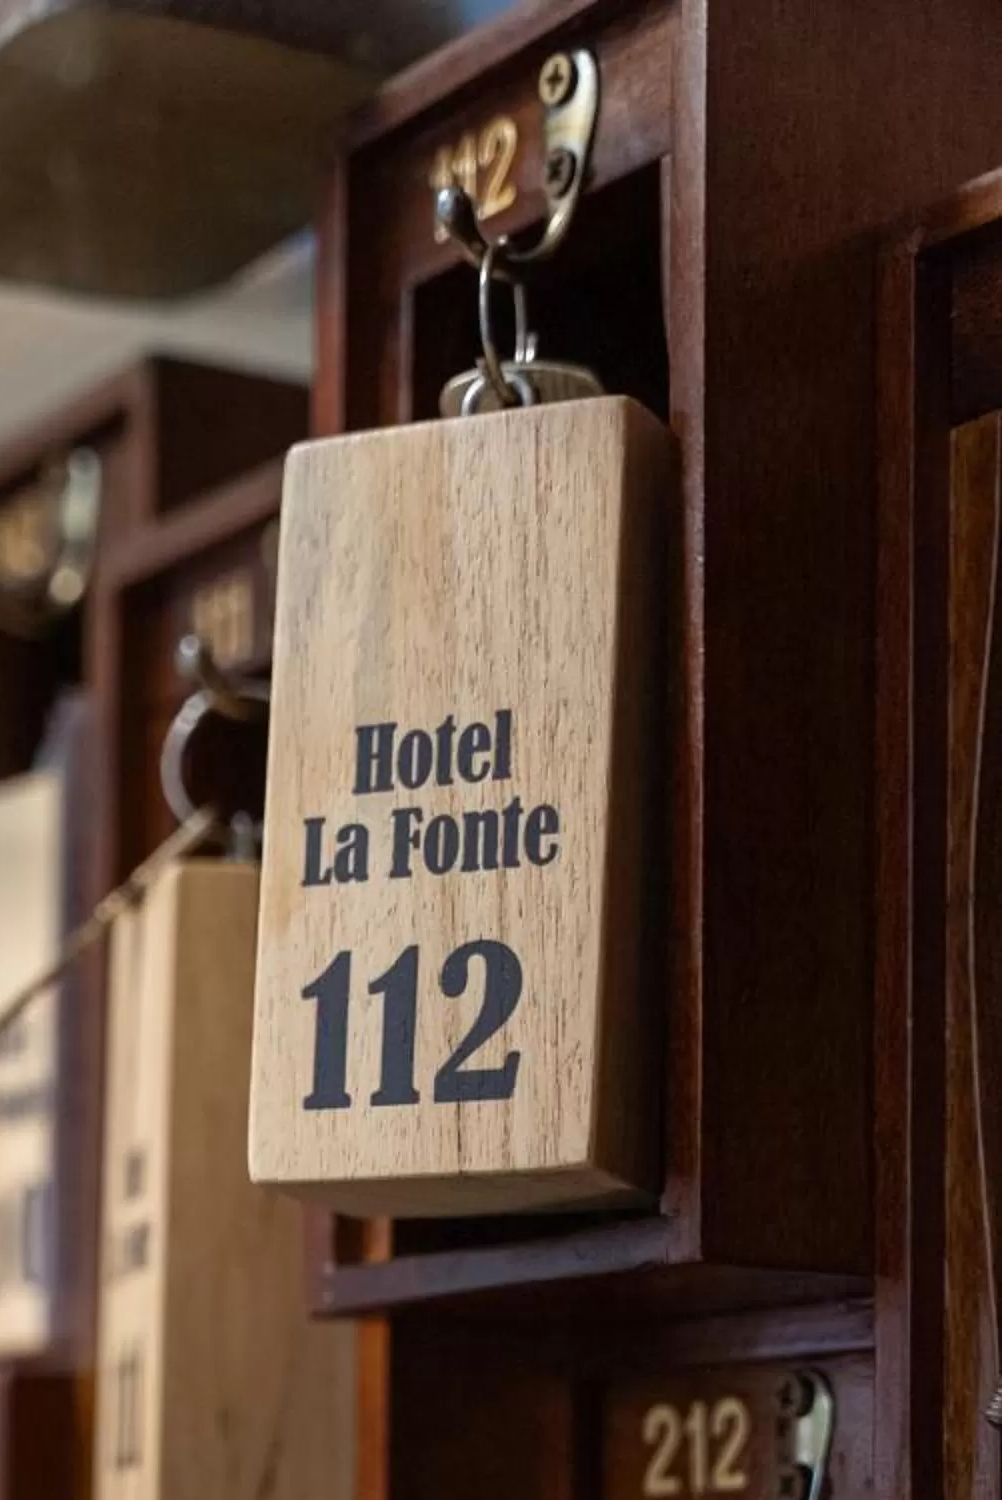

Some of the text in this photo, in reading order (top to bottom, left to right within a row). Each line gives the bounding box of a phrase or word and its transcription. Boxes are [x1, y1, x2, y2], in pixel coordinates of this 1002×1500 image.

[351, 708, 513, 796] Hotel
[300, 796, 560, 887] La Fonte
[300, 938, 523, 1111] 112
[641, 1396, 750, 1496] 212
